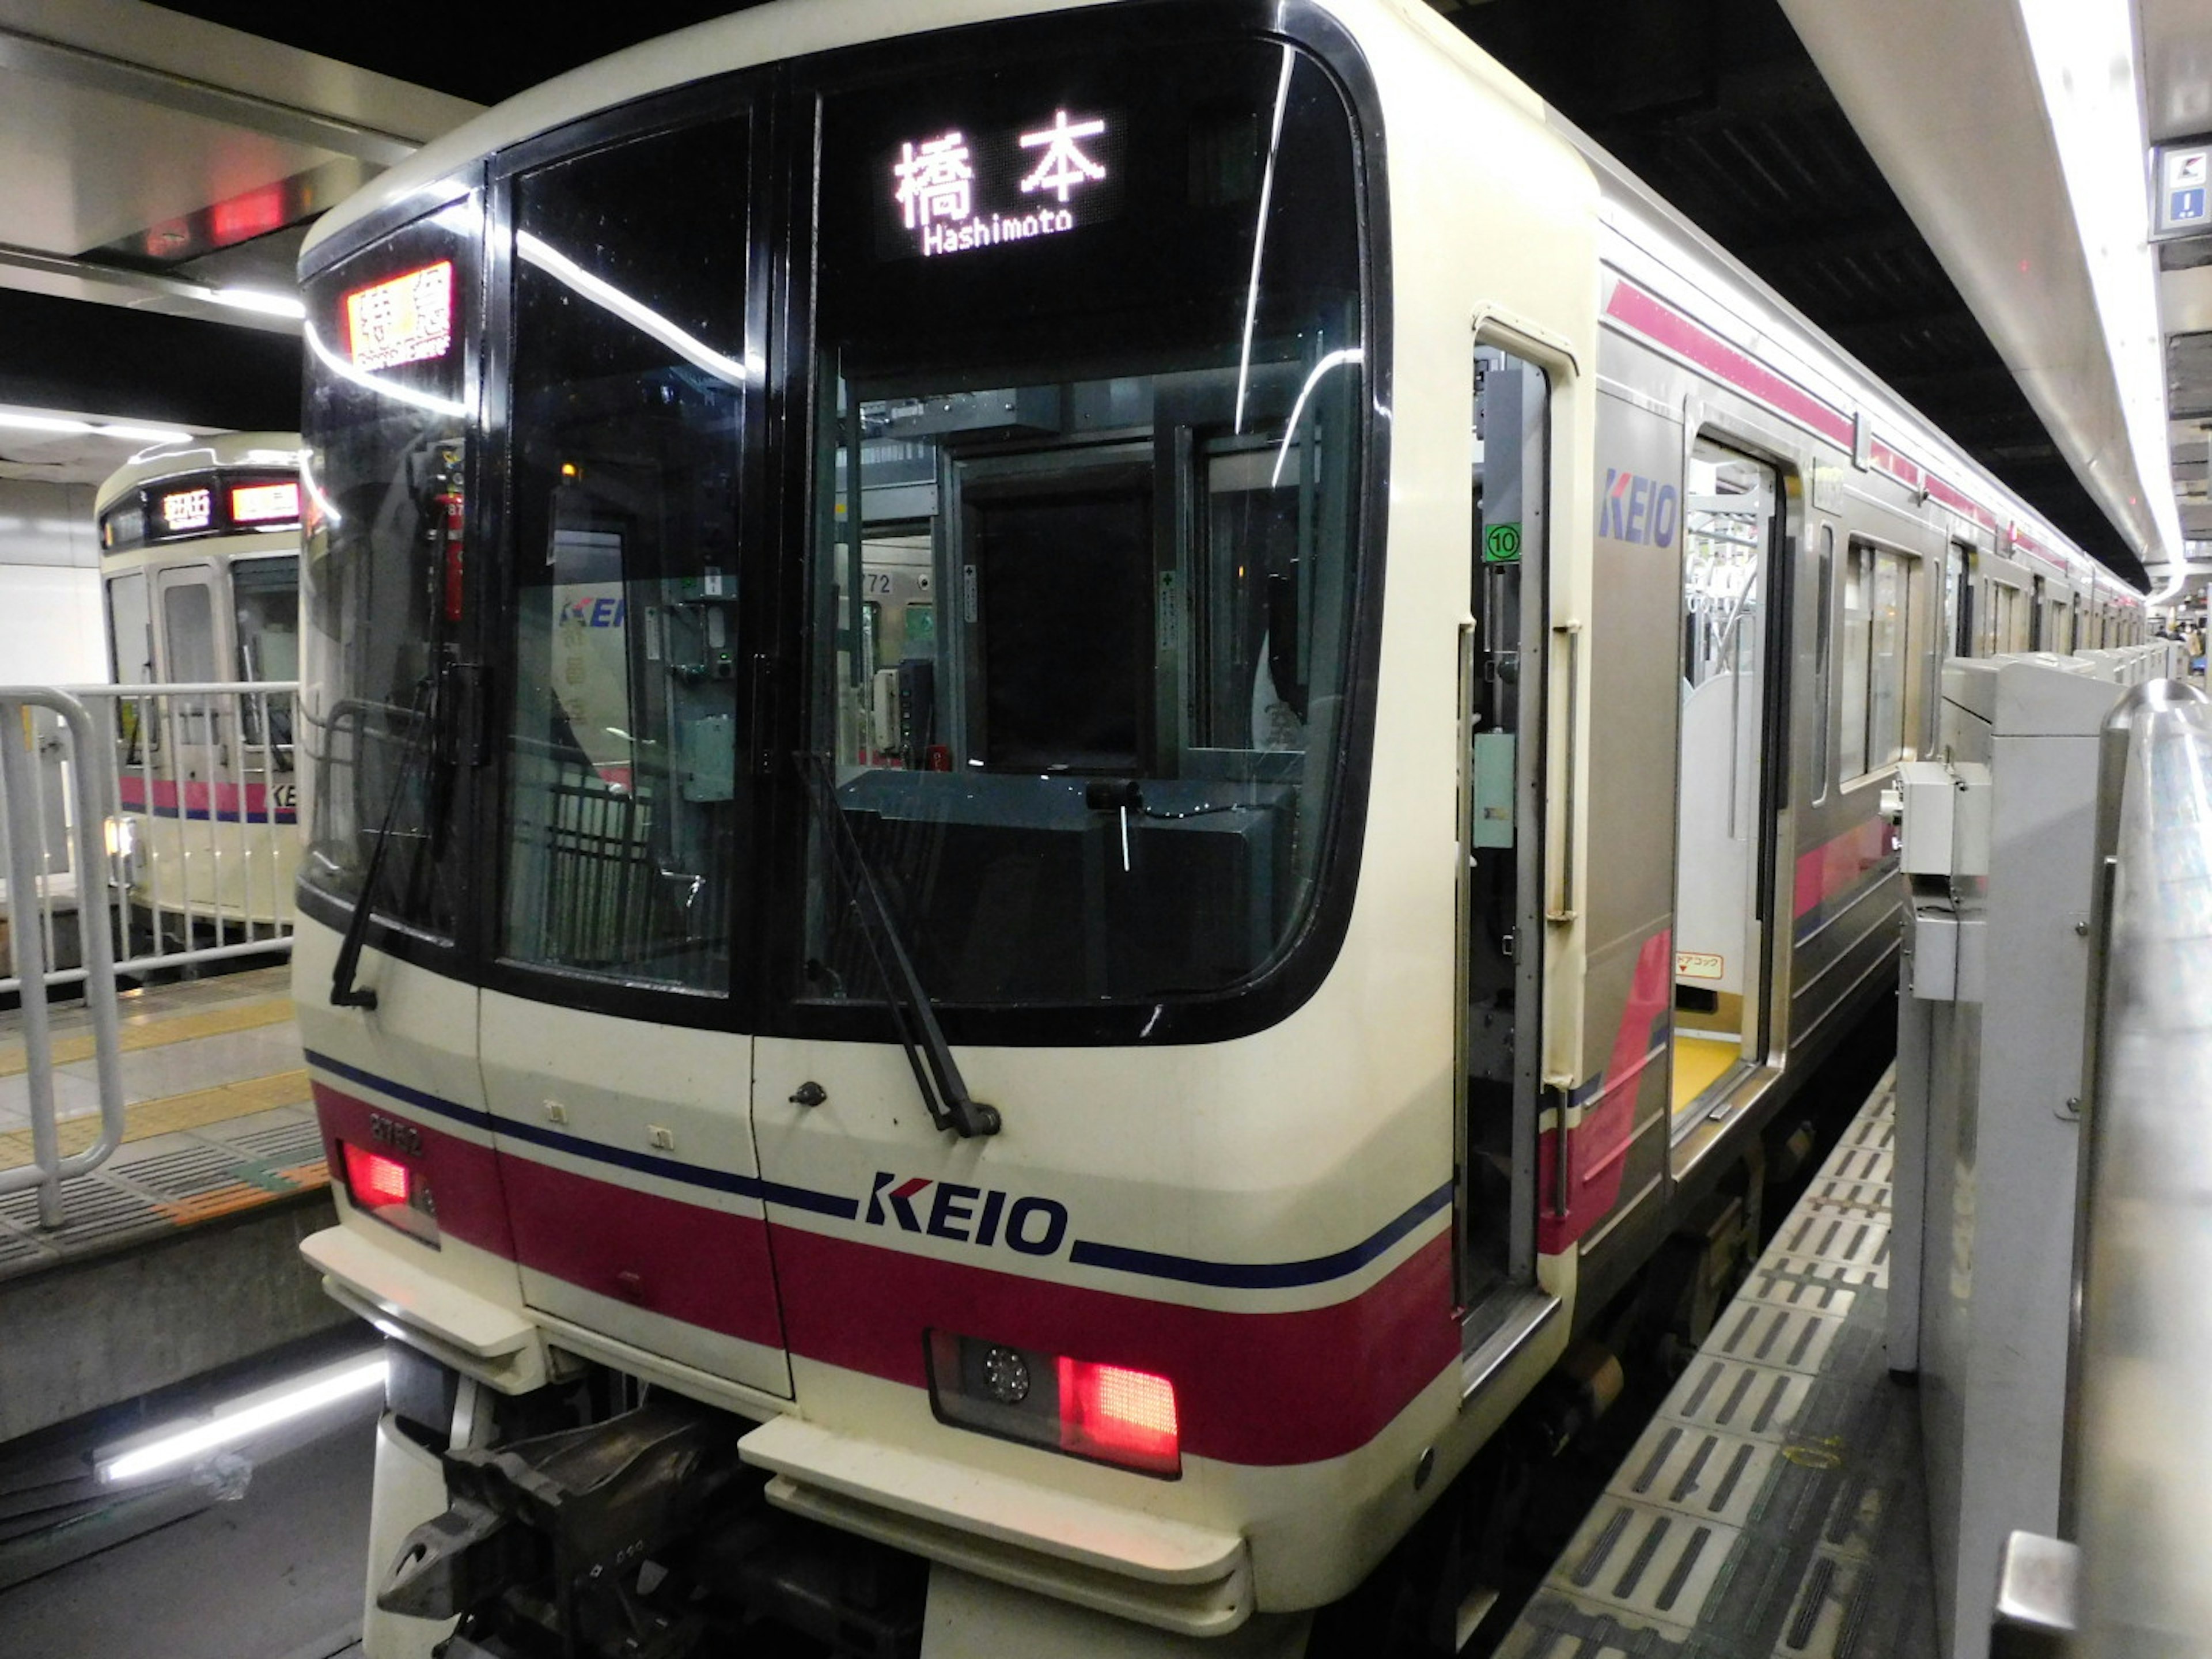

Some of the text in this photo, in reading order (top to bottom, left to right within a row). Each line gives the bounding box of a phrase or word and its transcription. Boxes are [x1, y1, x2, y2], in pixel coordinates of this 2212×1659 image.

[894, 110, 1106, 229] 橋本
[923, 209, 1072, 257] Hashimoto
[1492, 532, 1515, 552] 10
[1598, 467, 1677, 549] KEIO
[865, 1171, 1069, 1257] KEIO
